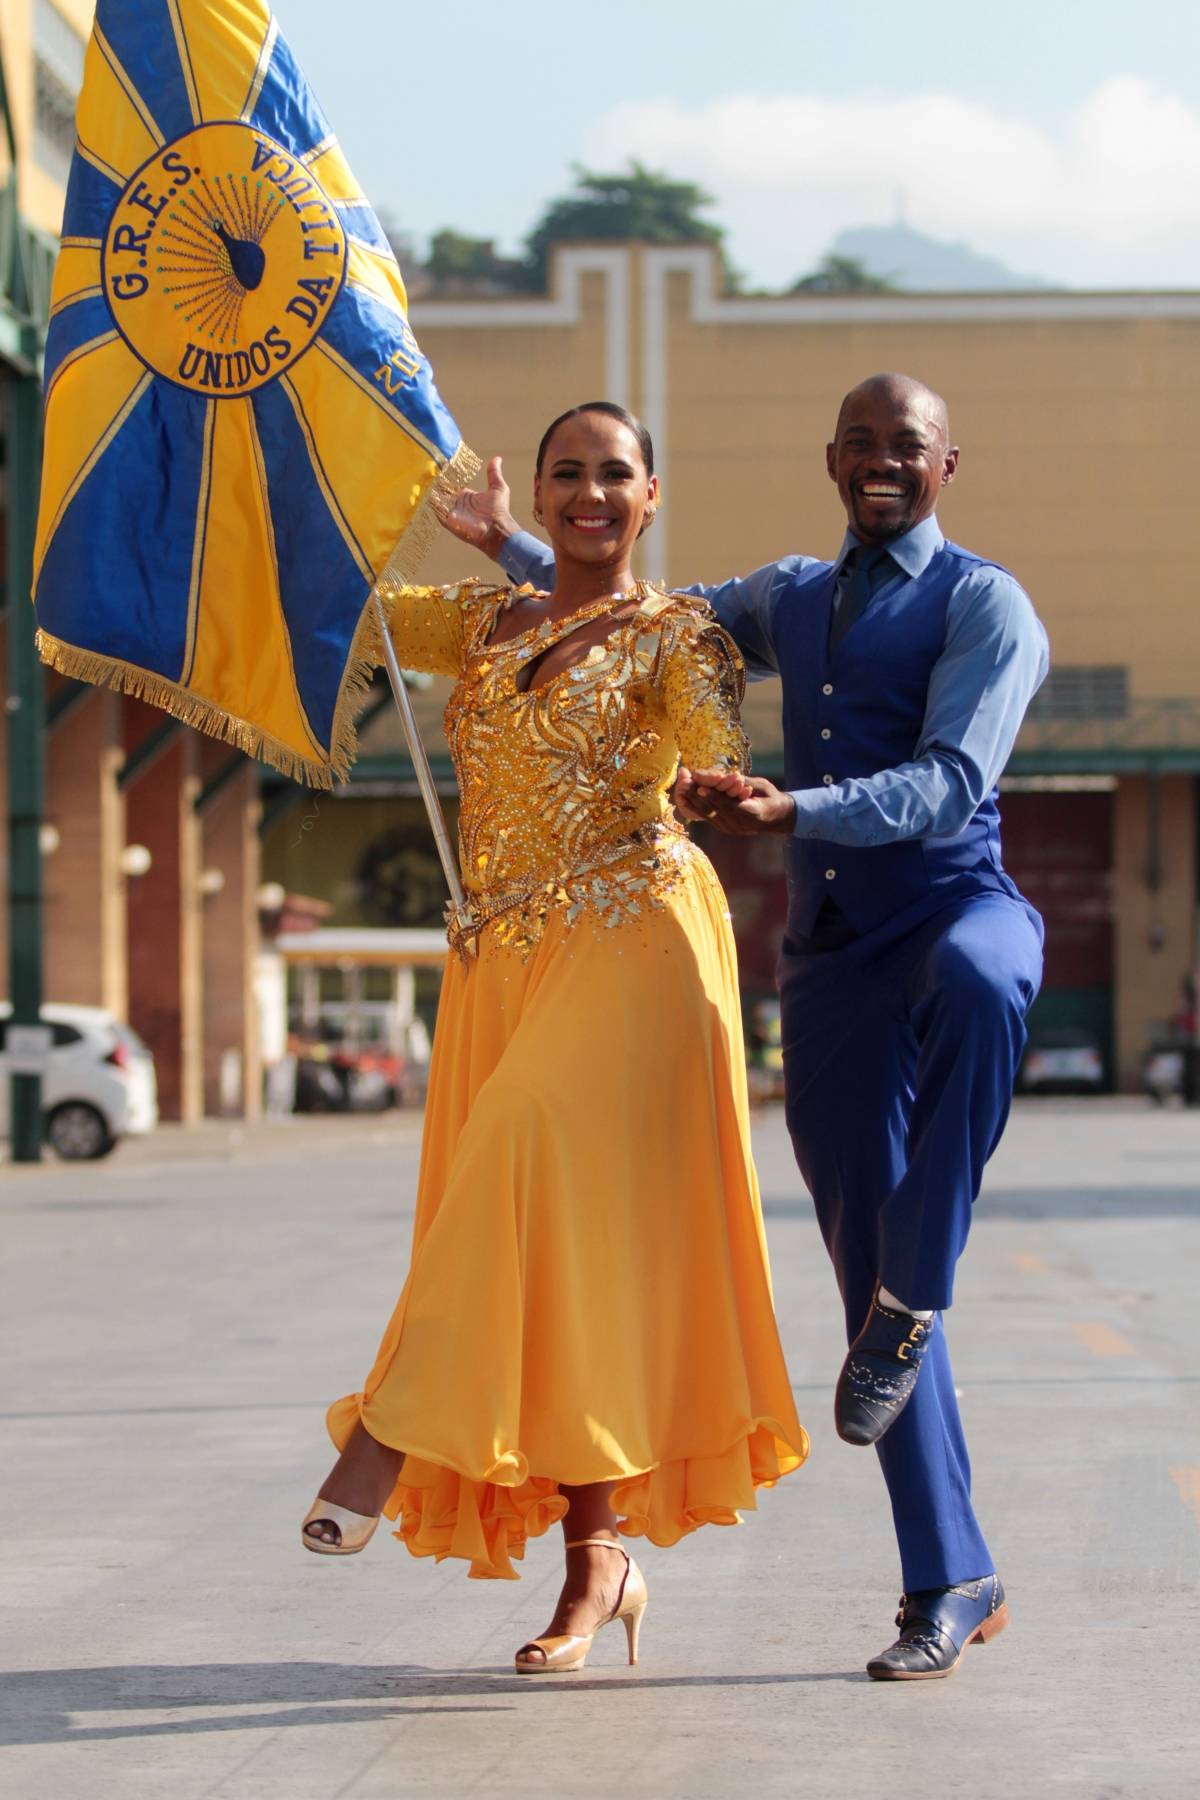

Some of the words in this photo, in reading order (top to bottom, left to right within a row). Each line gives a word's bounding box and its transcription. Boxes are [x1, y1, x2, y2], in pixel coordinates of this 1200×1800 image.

[111, 151, 201, 301] G.R.E.S.
[251, 137, 339, 260] TIJUCA
[285, 275, 335, 328] DA
[178, 325, 292, 389] UNIDOS
